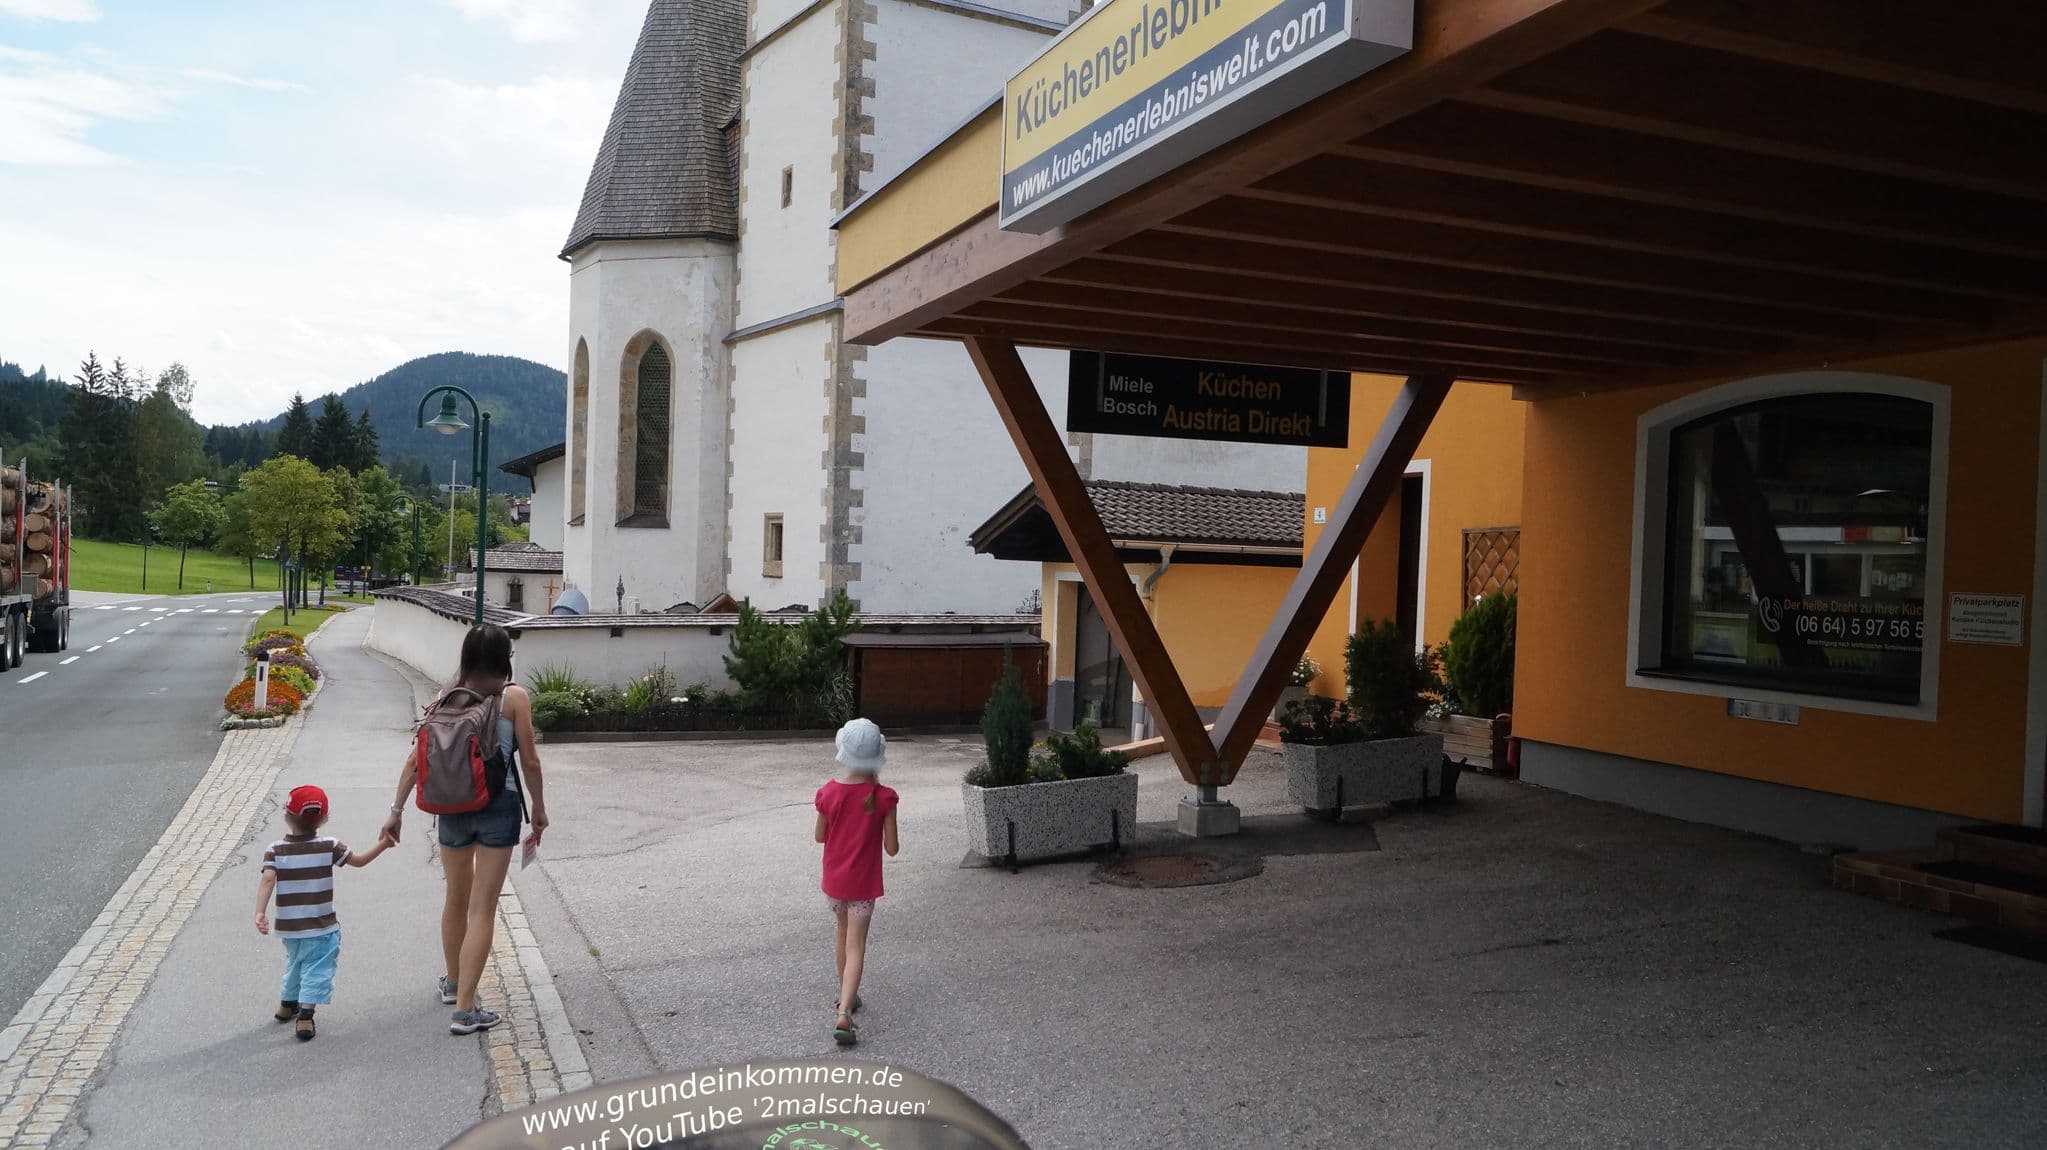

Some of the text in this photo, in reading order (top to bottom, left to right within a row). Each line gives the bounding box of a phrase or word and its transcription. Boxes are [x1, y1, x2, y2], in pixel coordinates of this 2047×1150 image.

[1016, 0, 1221, 140] Küchenerlebn
[1012, 1, 1327, 207] www.kuechenerlebniswelt.com
[1109, 375, 1155, 394] Miele
[1197, 371, 1282, 401] Küchen
[1103, 397, 1158, 417] Bosch
[1162, 403, 1312, 437] Austria Direkt
[1784, 599, 1801, 610] Der
[1831, 600, 1859, 613] Draht
[1860, 603, 1872, 613] zu
[1875, 603, 1899, 615] Ihrer
[1953, 596, 2021, 608] Privatparkplatz
[1795, 614, 1818, 636] (06
[1822, 616, 1846, 638] 64)
[1851, 619, 1861, 635] 5
[1865, 619, 1885, 636] 97
[1890, 620, 1911, 638] 56
